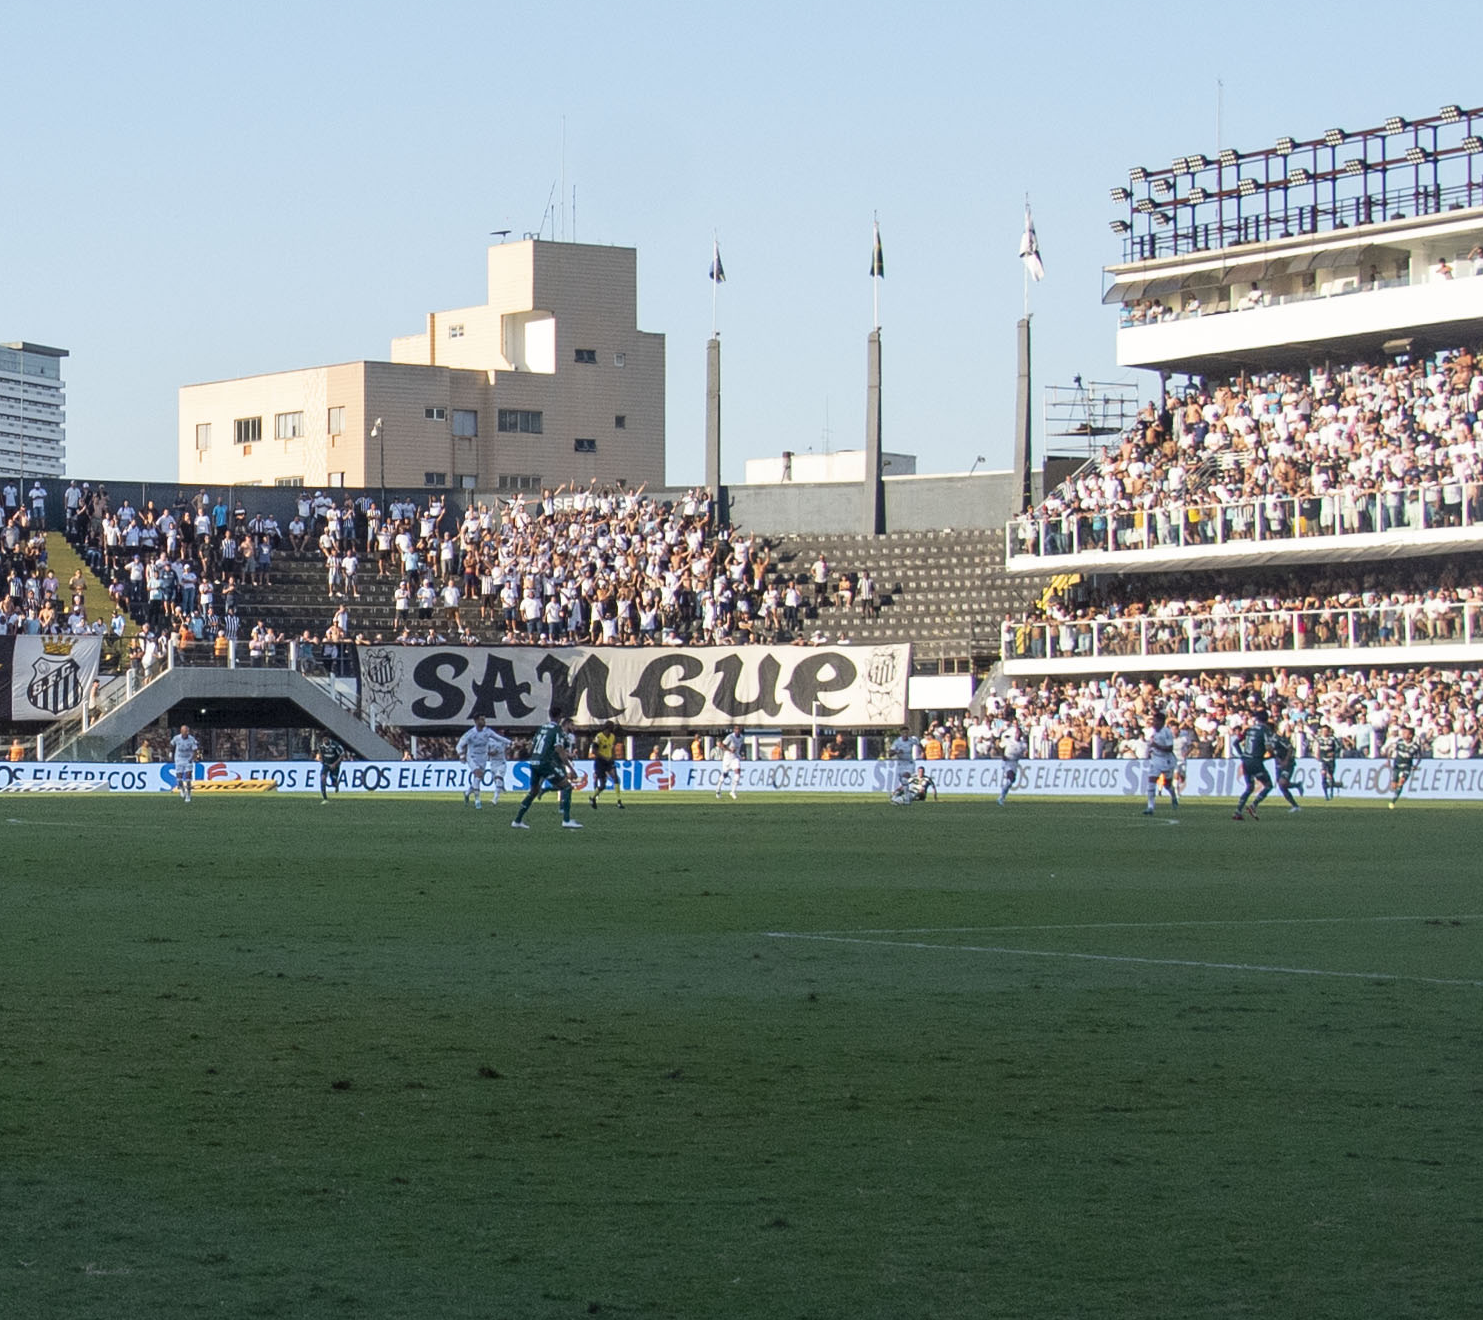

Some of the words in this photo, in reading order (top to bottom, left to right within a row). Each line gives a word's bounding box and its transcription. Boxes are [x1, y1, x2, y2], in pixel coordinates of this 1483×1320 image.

[33, 764, 148, 790] ELÉTRICOS
[250, 769, 298, 788] FIOS
[305, 769, 317, 788] E
[398, 764, 496, 789] ELÉTRIO
[749, 764, 793, 790] CABOS
[795, 763, 866, 788] ELÉTRICOS
[966, 768, 977, 787] E
[1036, 763, 1120, 789] ELÉTRICOS
[1340, 764, 1400, 794] CABO
